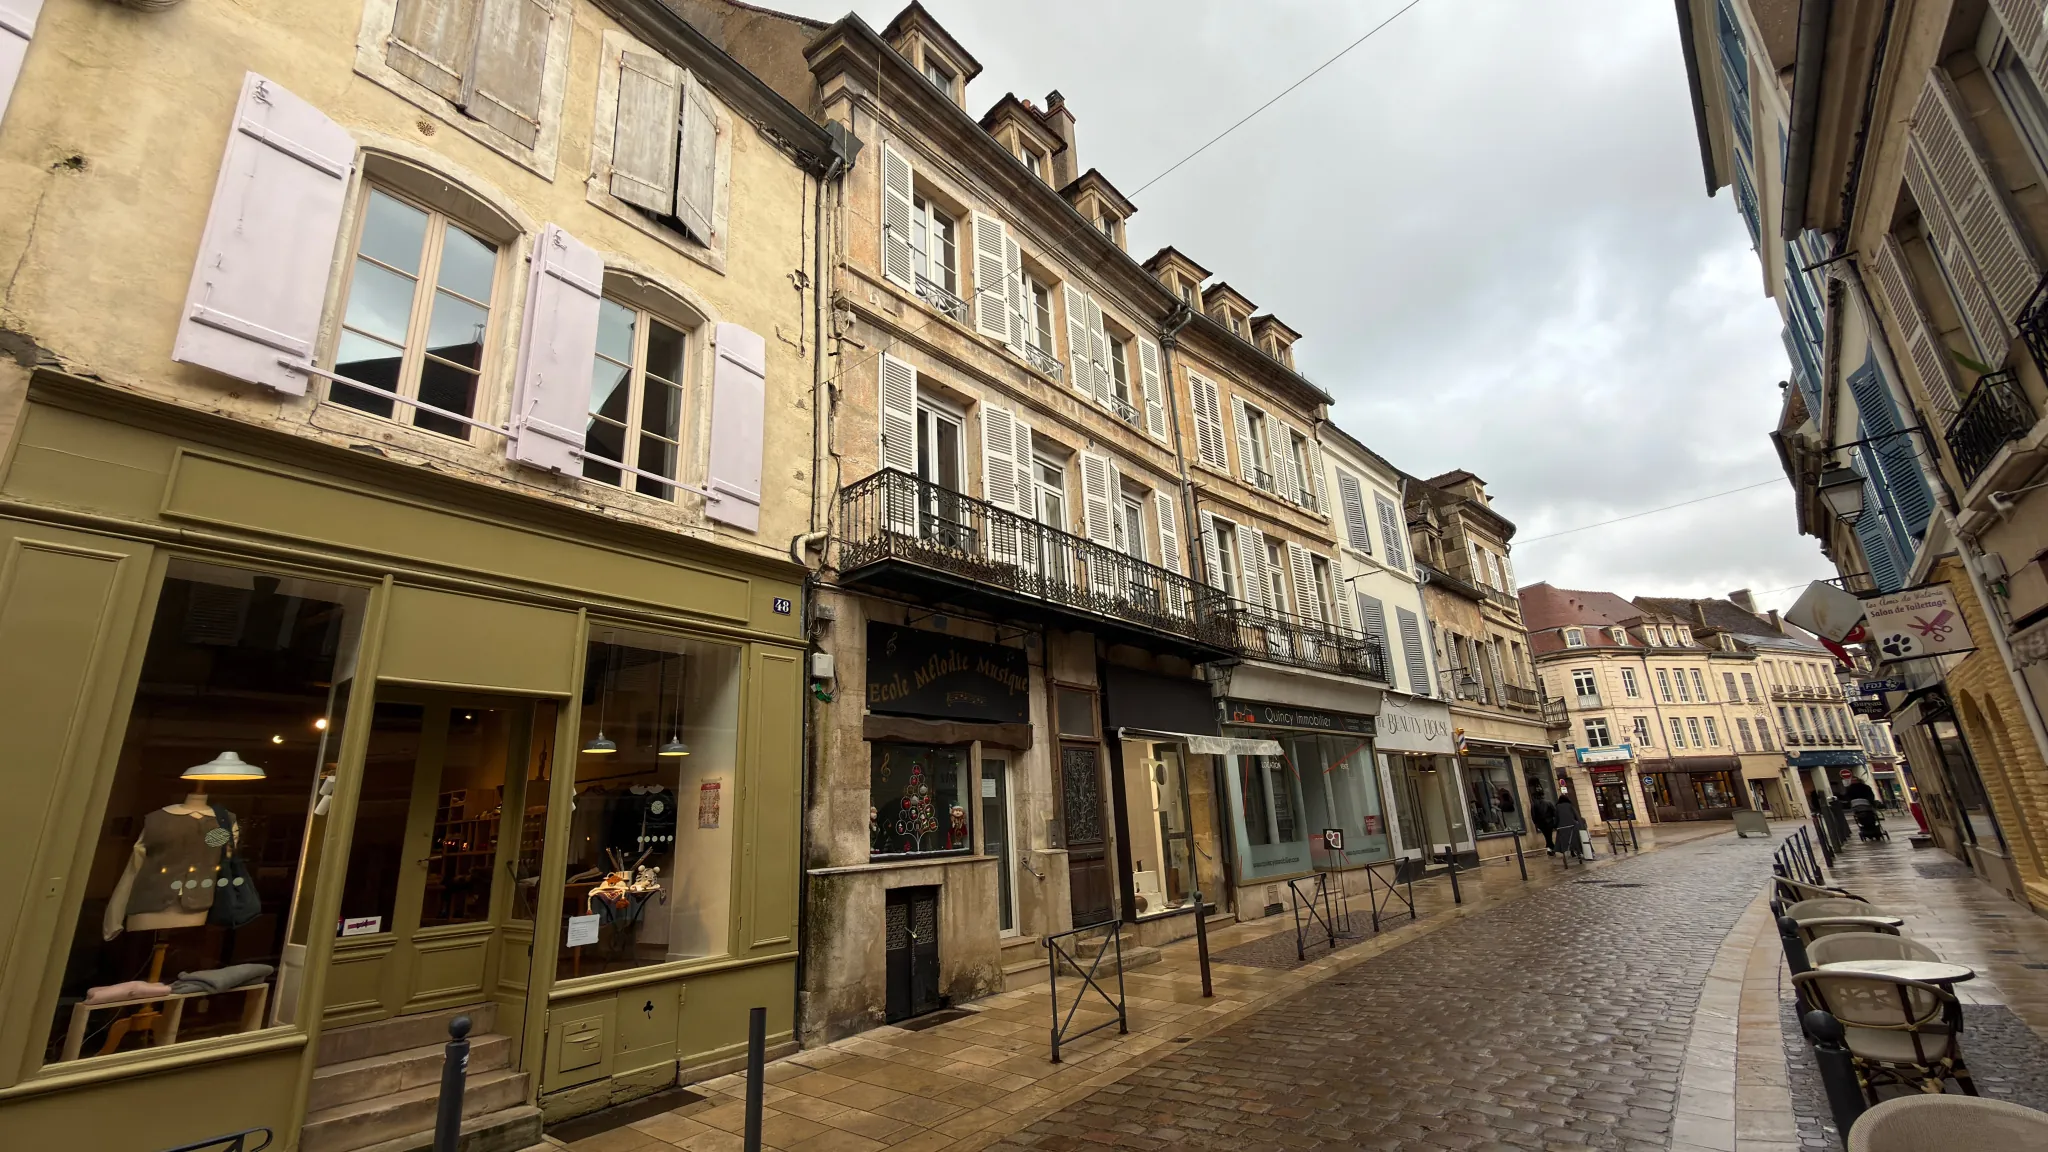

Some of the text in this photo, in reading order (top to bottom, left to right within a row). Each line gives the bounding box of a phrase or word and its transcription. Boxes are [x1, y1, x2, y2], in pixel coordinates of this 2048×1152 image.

[774, 599, 789, 613] 48
[1870, 599, 1947, 618] Salon de Toilettage
[867, 672, 911, 703] Ecole
[976, 655, 1028, 696] Musique
[1865, 682, 1882, 690] FDJ
[1264, 707, 1294, 724] Quincy
[1295, 710, 1331, 727] Immobilier
